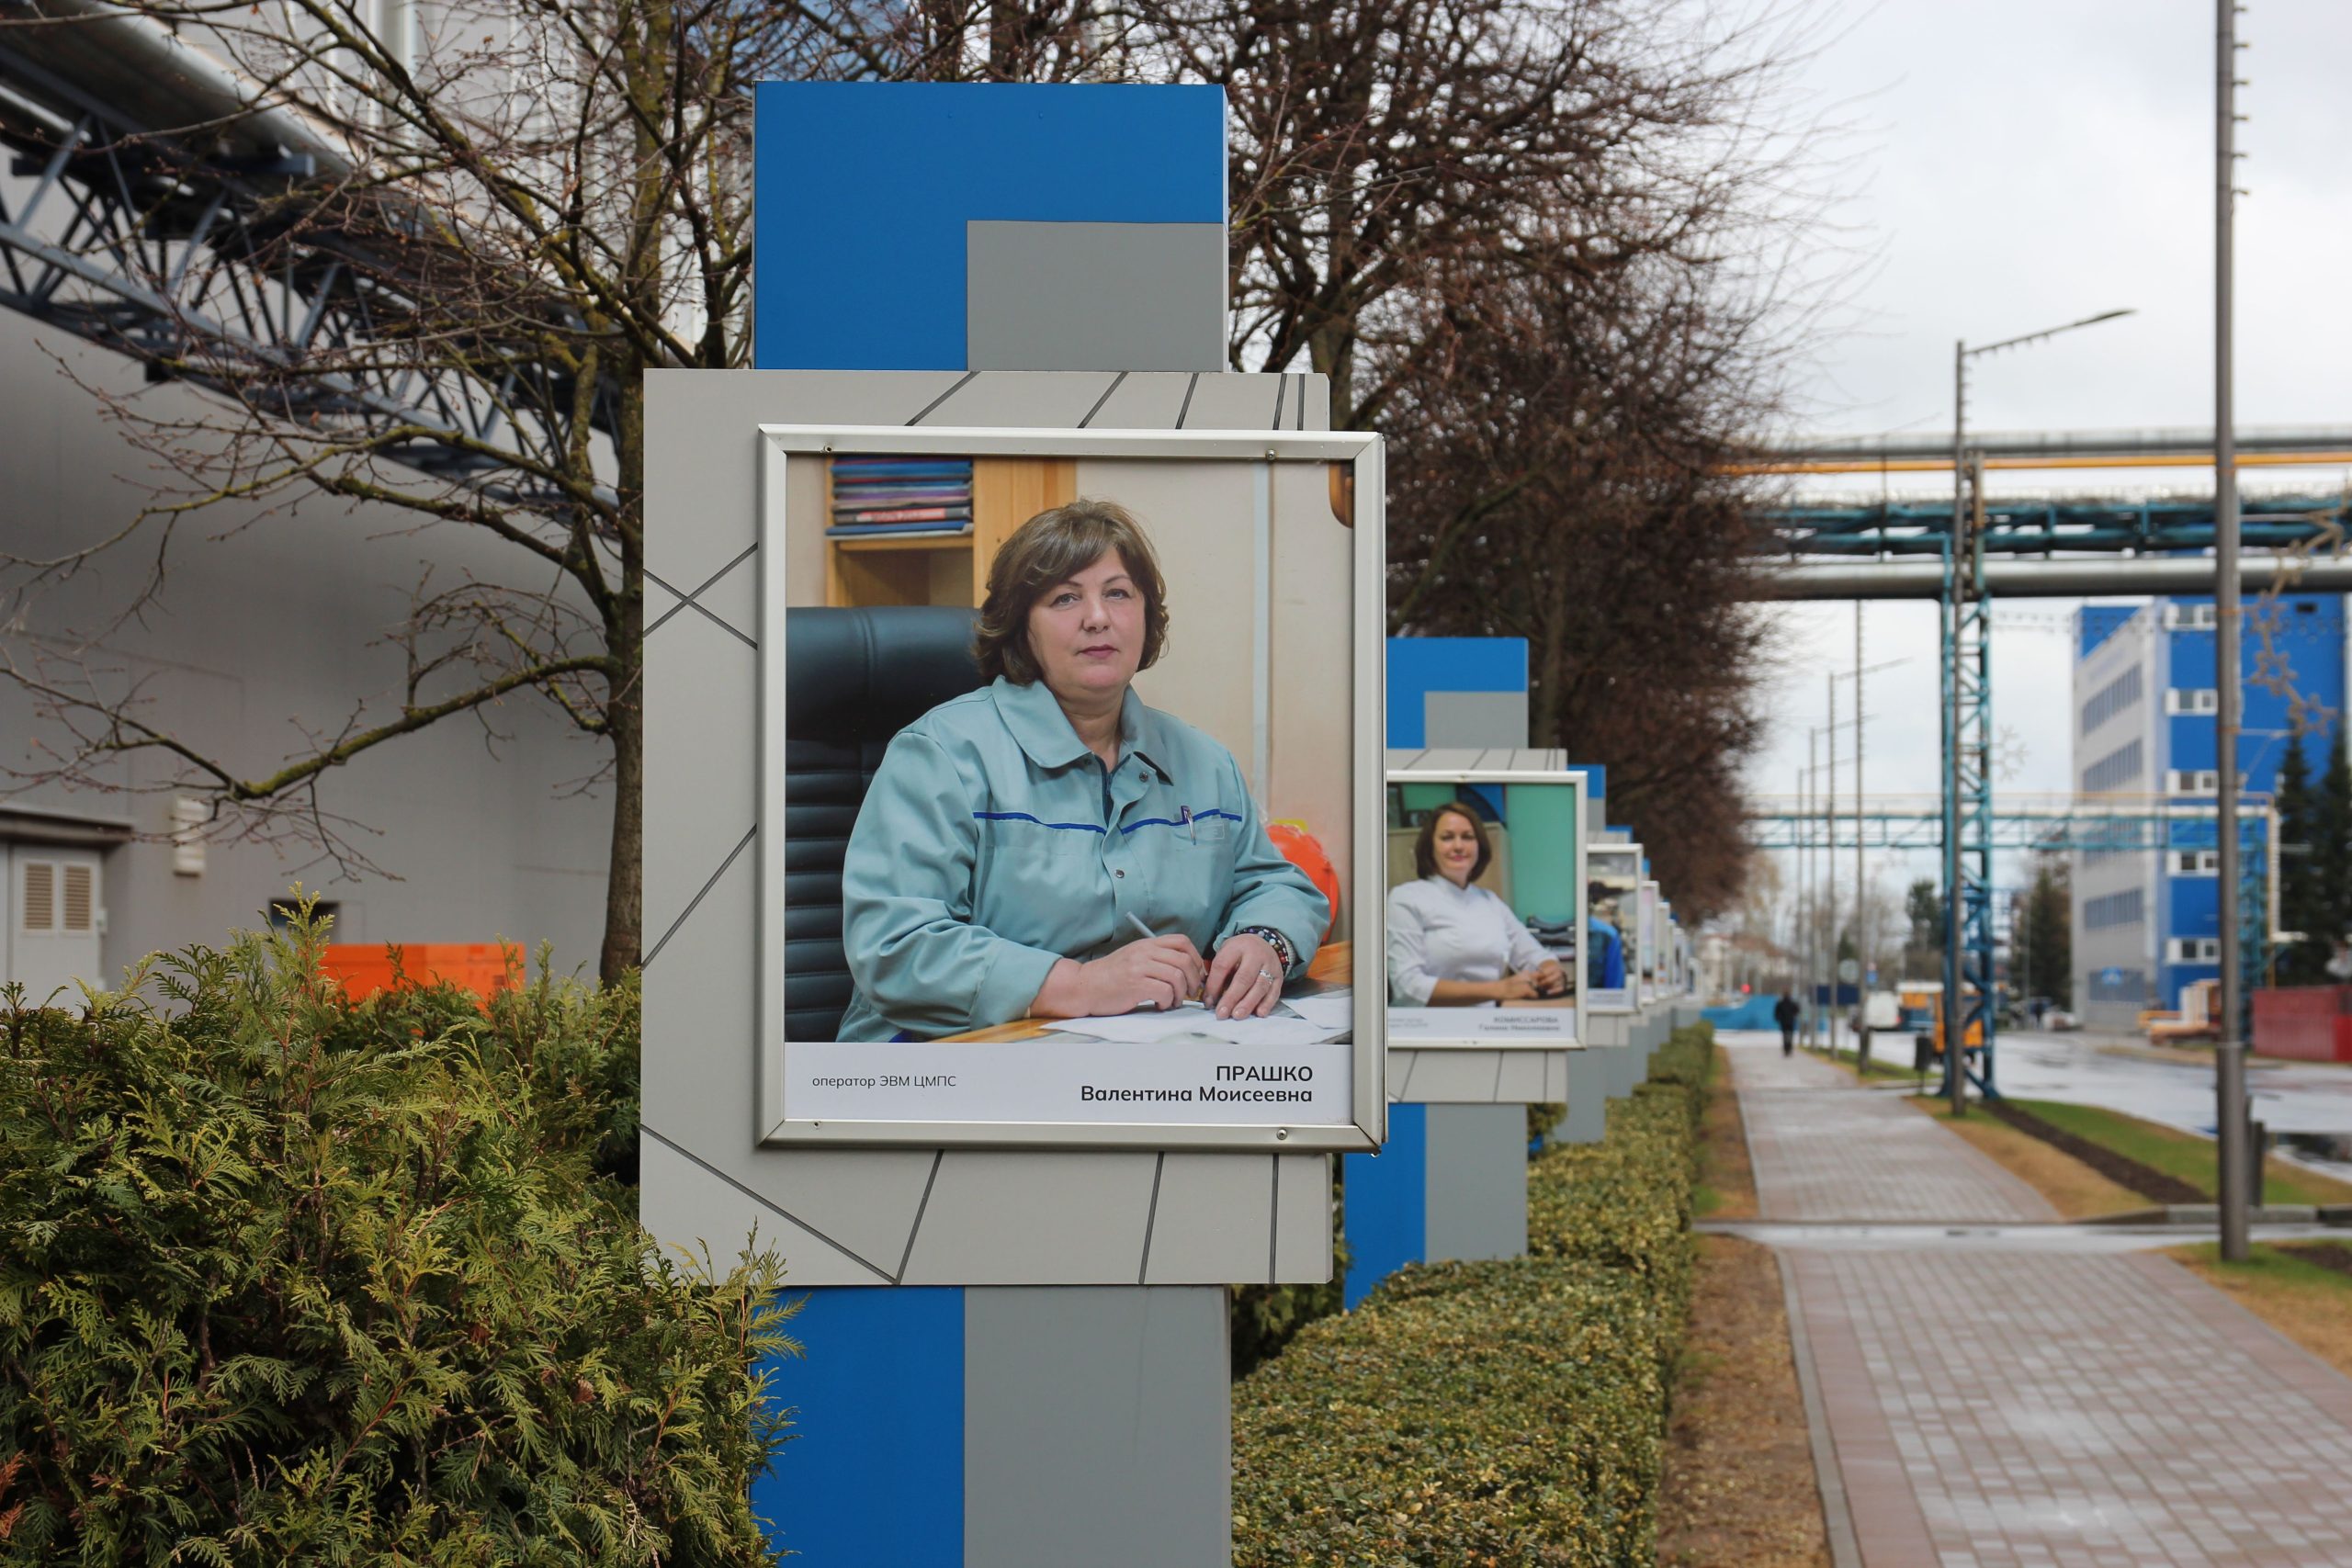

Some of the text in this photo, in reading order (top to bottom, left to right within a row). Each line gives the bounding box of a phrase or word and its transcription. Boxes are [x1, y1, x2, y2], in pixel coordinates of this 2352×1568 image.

[1216, 1066, 1314, 1082] ПРАШКО
[811, 1075, 956, 1090] оператор ЭВМ ЦМПС
[1080, 1086, 1313, 1102] Валентина Моисеевна
